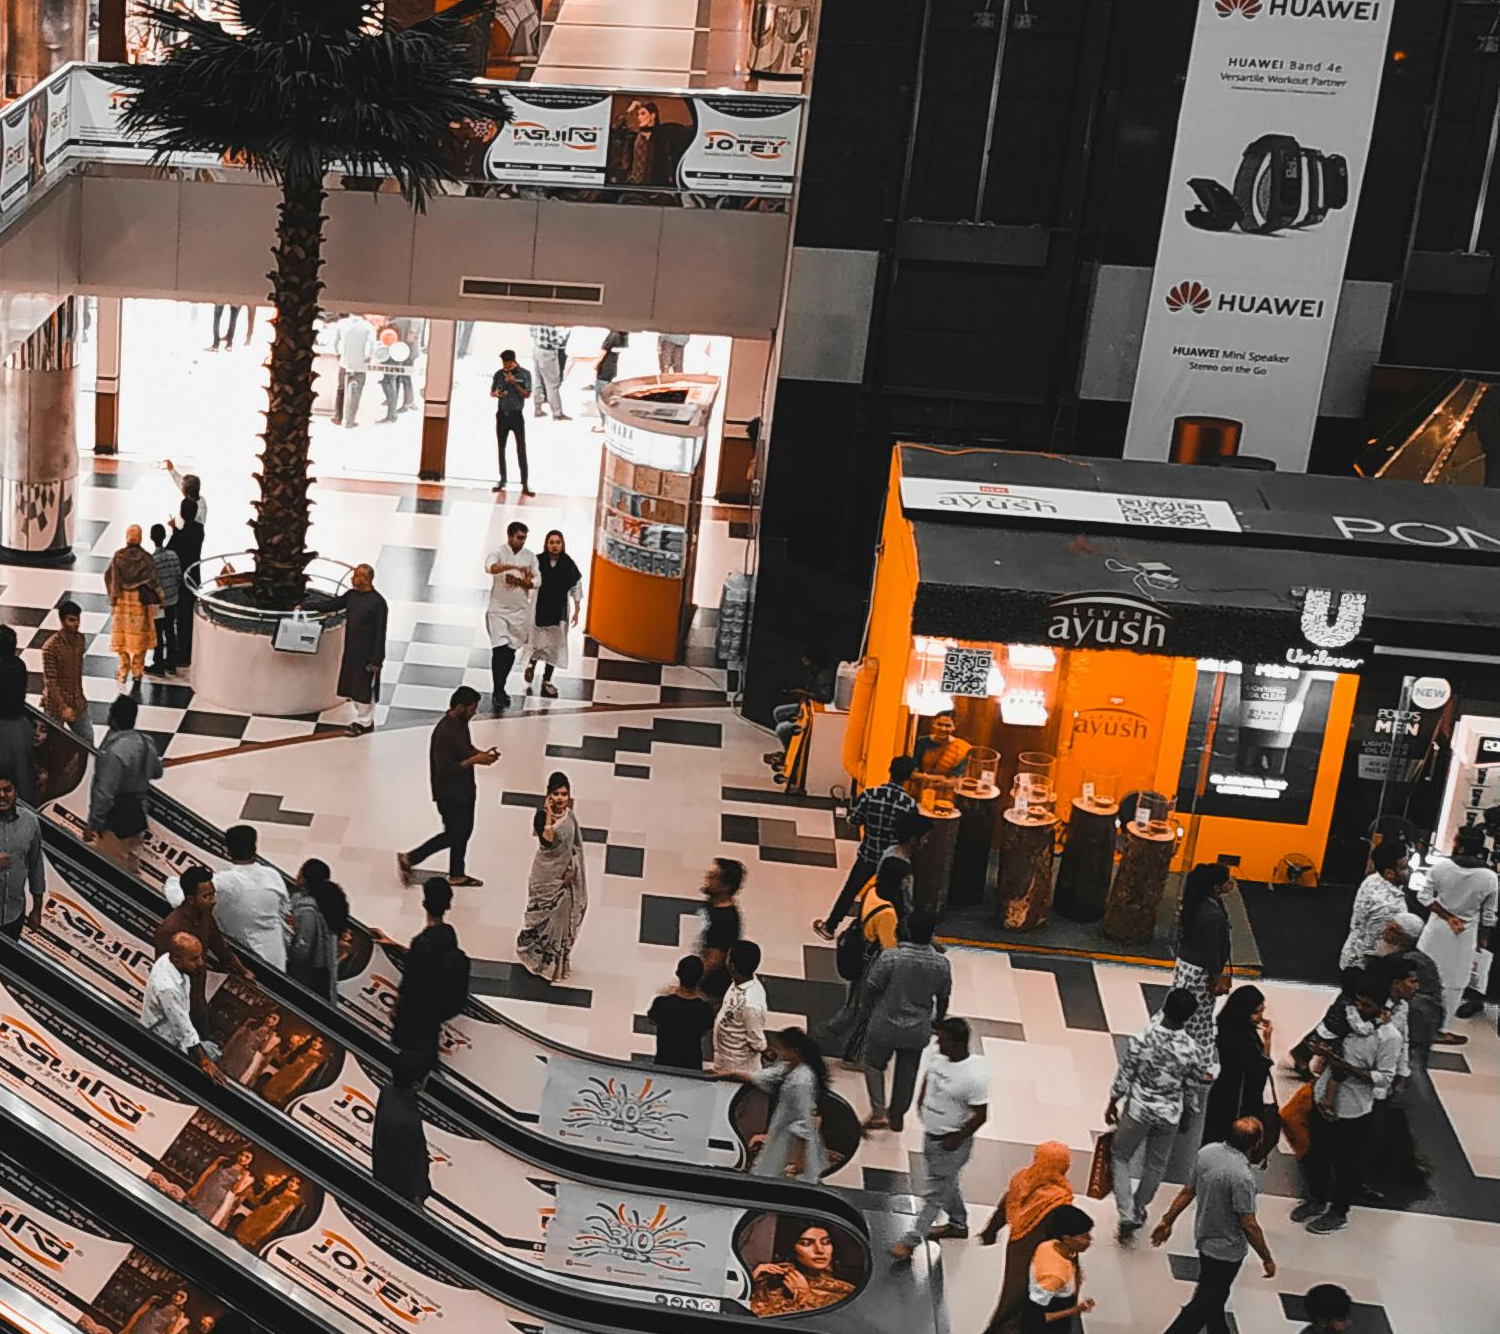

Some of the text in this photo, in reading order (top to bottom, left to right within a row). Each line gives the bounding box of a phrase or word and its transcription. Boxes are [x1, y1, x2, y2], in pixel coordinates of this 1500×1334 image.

[1228, 57, 1342, 73] HUAWEI Band 4e
[1267, 74, 1309, 85] Workout
[1310, 76, 1347, 87] Partner
[704, 137, 786, 154] JOTEY
[1218, 293, 1324, 319] HUAWEI
[1172, 346, 1290, 364] HUAWEI Mini Speaker
[1188, 361, 1267, 375] Stereo on the Go
[938, 495, 1057, 514] ayush
[1072, 607, 1142, 621] LEVER
[1048, 614, 1167, 648] ayush
[1286, 648, 1365, 669] Unilever
[1415, 687, 1447, 699] NEW
[1074, 716, 1148, 739] ayush
[1374, 720, 1420, 736] MEN
[312, 1238, 436, 1317] JOTEY
